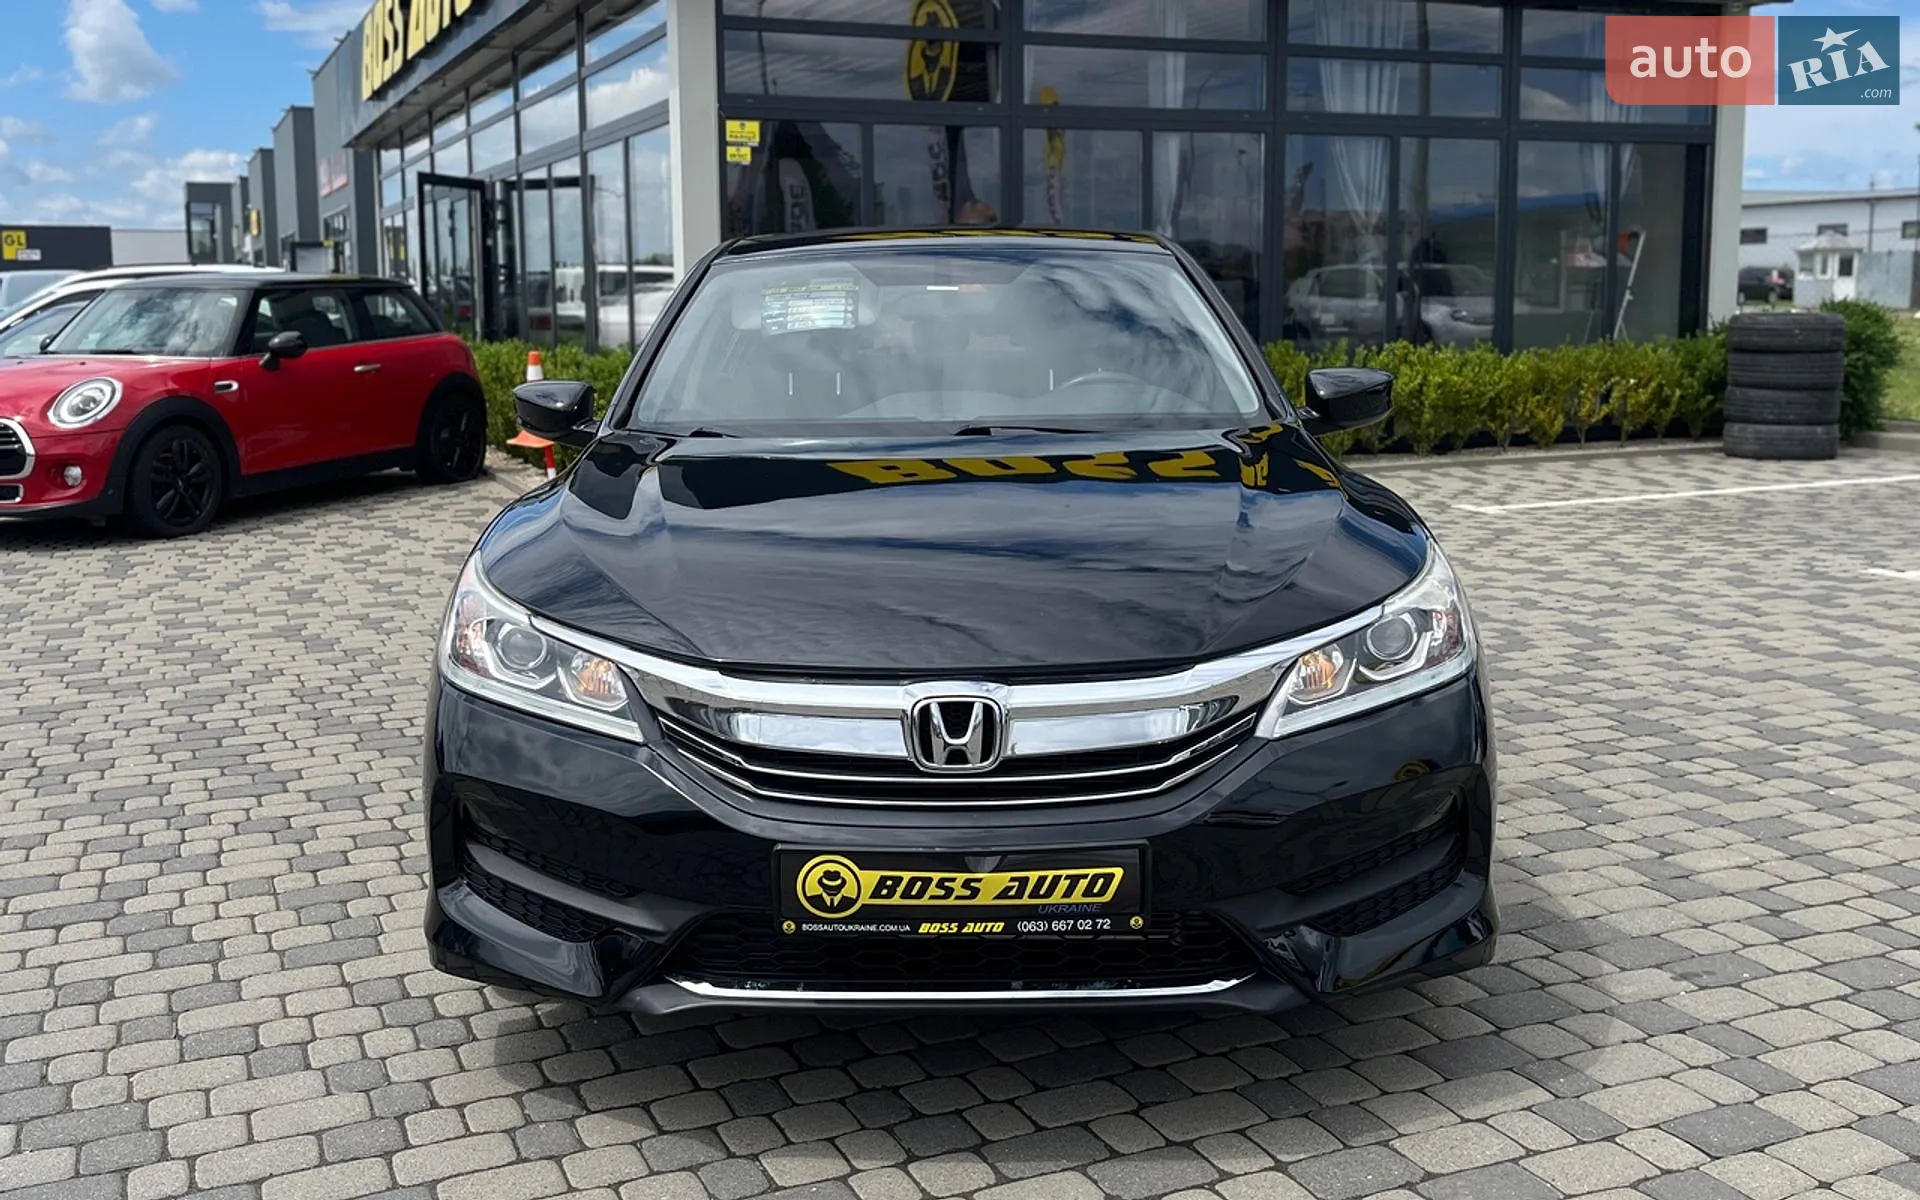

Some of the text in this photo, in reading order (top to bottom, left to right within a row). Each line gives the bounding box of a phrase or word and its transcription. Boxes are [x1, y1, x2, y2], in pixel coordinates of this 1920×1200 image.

[362, 0, 404, 102] BOSS
[4, 233, 25, 247] GL
[869, 872, 1116, 901] BOSS AUTO
[1038, 903, 1102, 914] UKRAINE
[801, 918, 1111, 934] BOSSAUTOUKRAINE.COM.UA BOSS AUTO (063) 667 02 72
